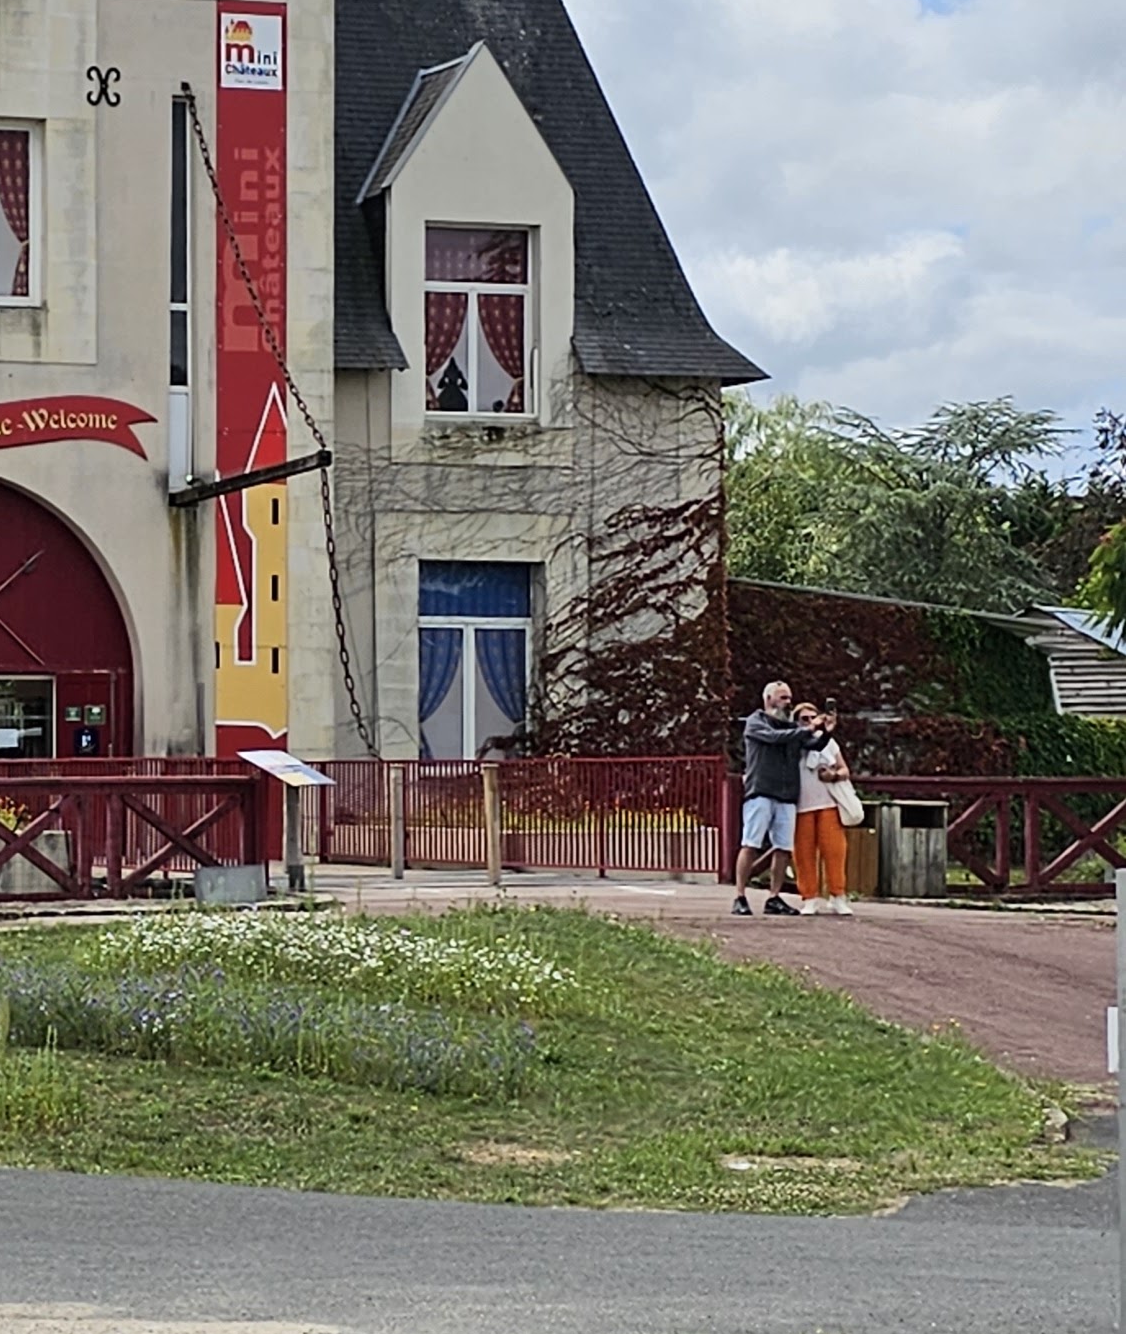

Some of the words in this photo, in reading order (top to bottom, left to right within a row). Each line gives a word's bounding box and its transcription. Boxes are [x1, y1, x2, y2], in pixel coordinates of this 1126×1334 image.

[225, 43, 278, 65] mini
[224, 148, 258, 351] mini
[21, 408, 118, 432] Welcome
